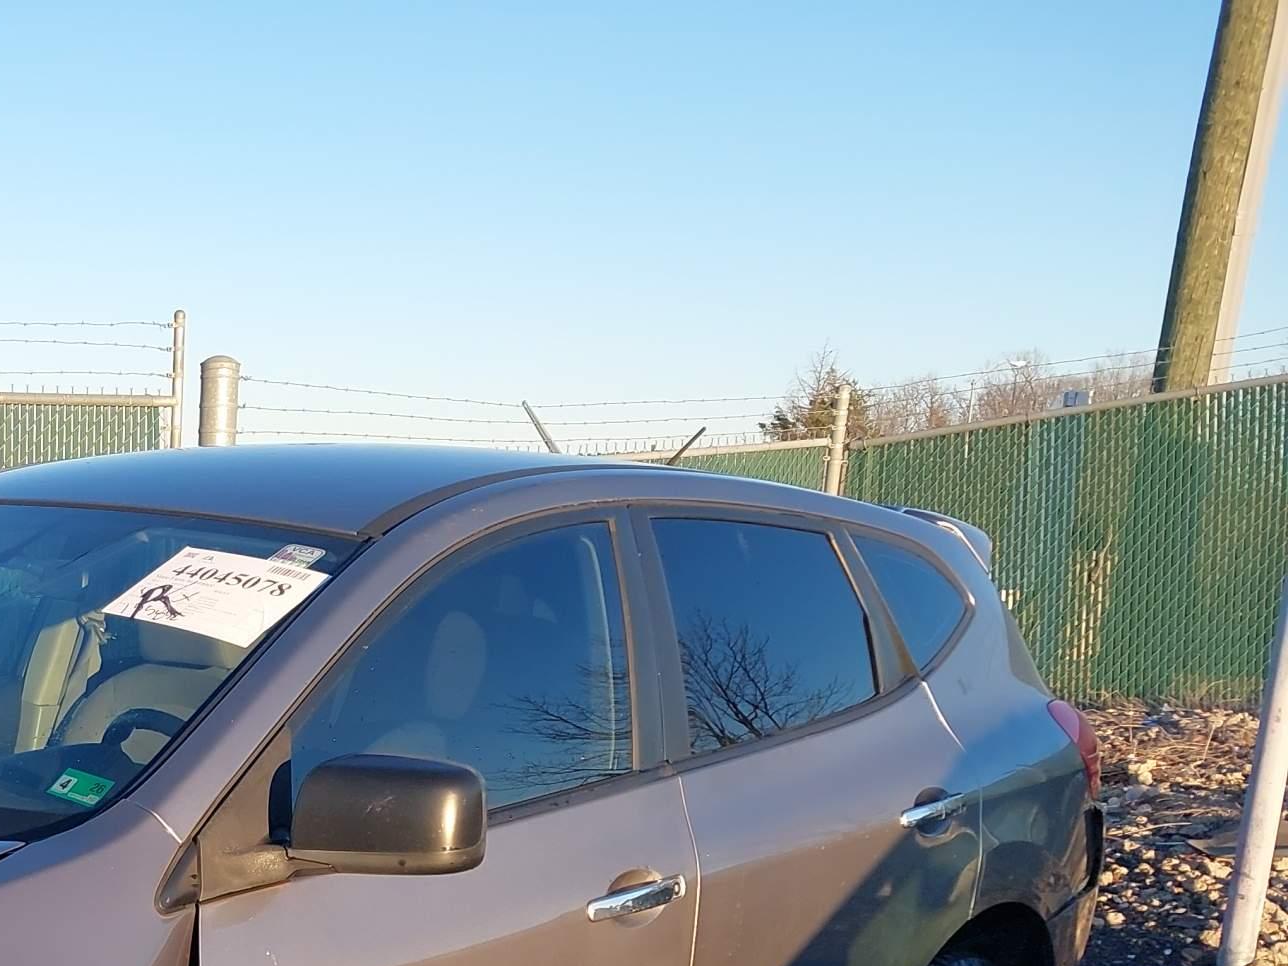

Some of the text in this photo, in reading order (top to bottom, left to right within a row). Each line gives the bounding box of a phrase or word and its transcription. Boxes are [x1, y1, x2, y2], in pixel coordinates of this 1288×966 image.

[171, 563, 293, 597] 44045078
[59, 778, 73, 791] 4
[88, 782, 106, 793] 26
